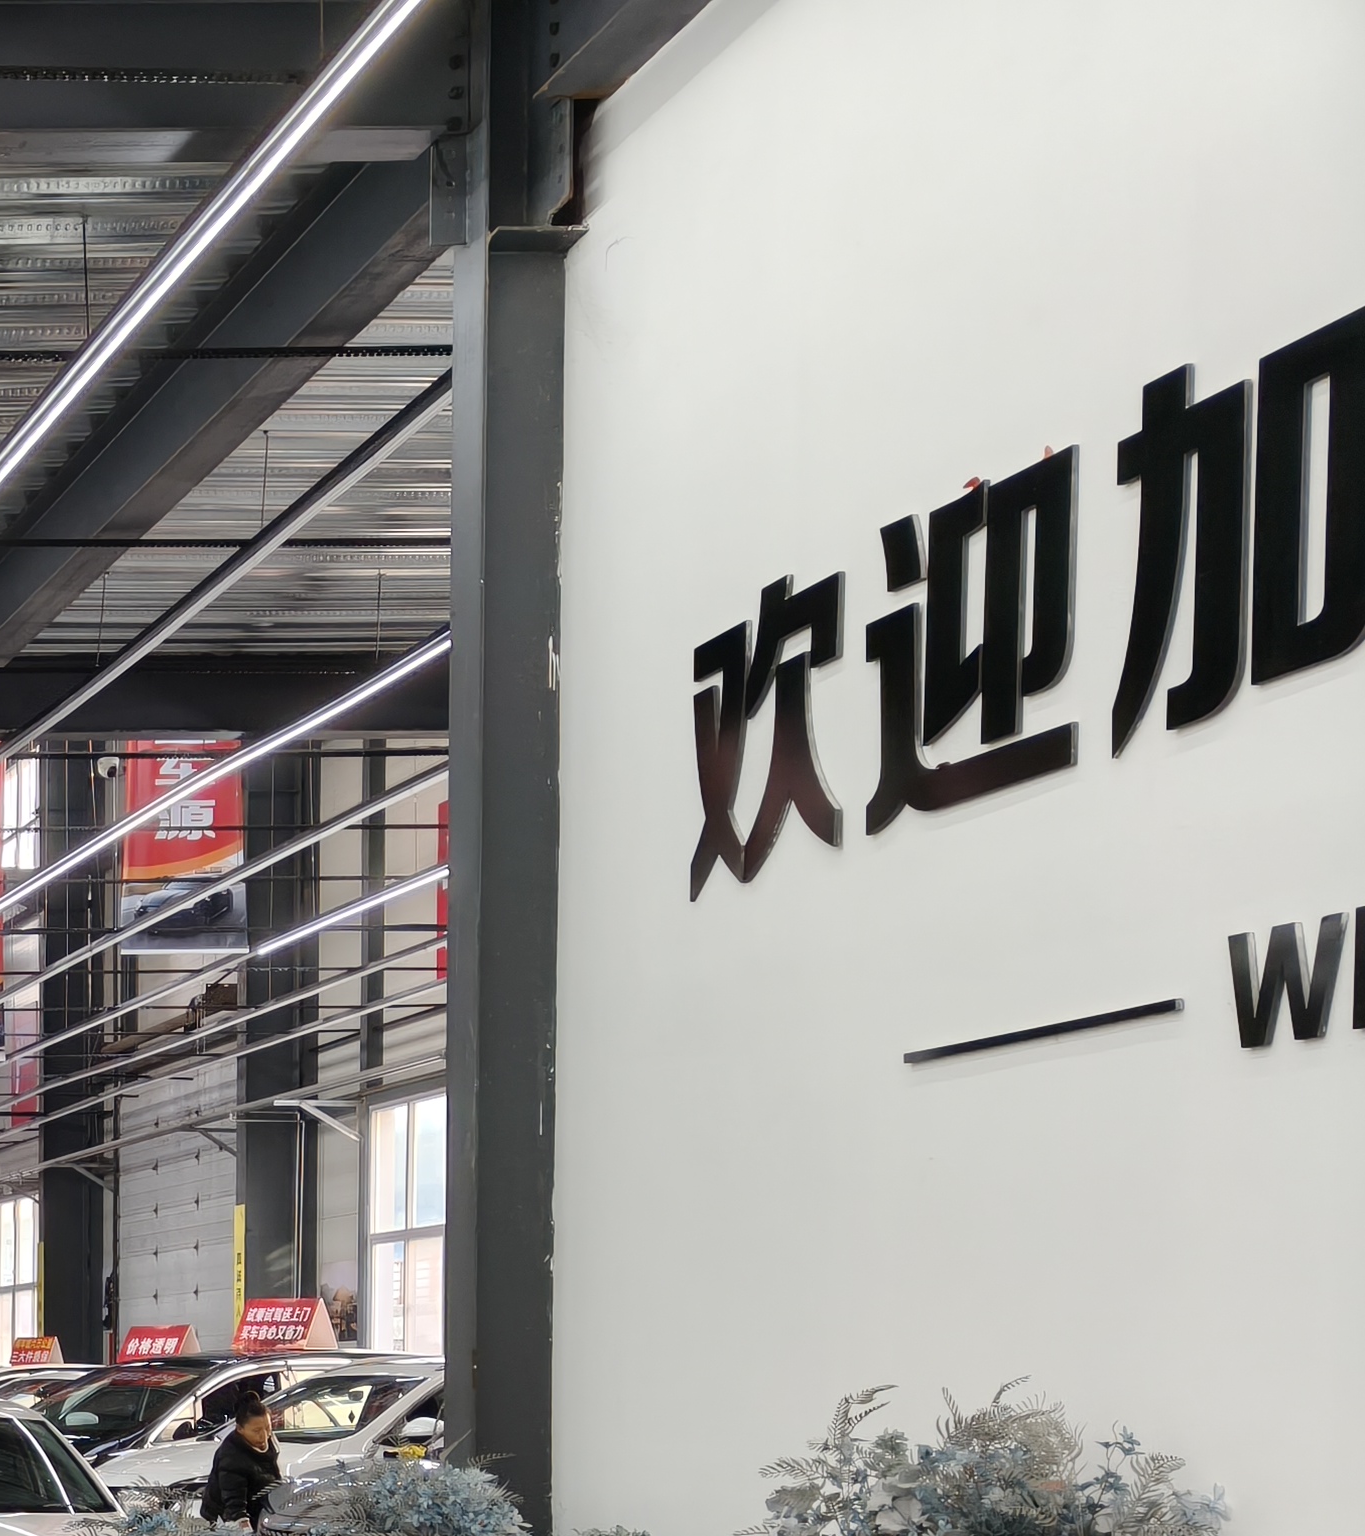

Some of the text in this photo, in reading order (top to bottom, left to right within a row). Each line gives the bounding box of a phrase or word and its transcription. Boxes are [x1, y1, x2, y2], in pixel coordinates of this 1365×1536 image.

[690, 306, 1365, 902] 欢迎加
[1226, 905, 1365, 1050] W
[126, 1337, 178, 1355] 价格透明
